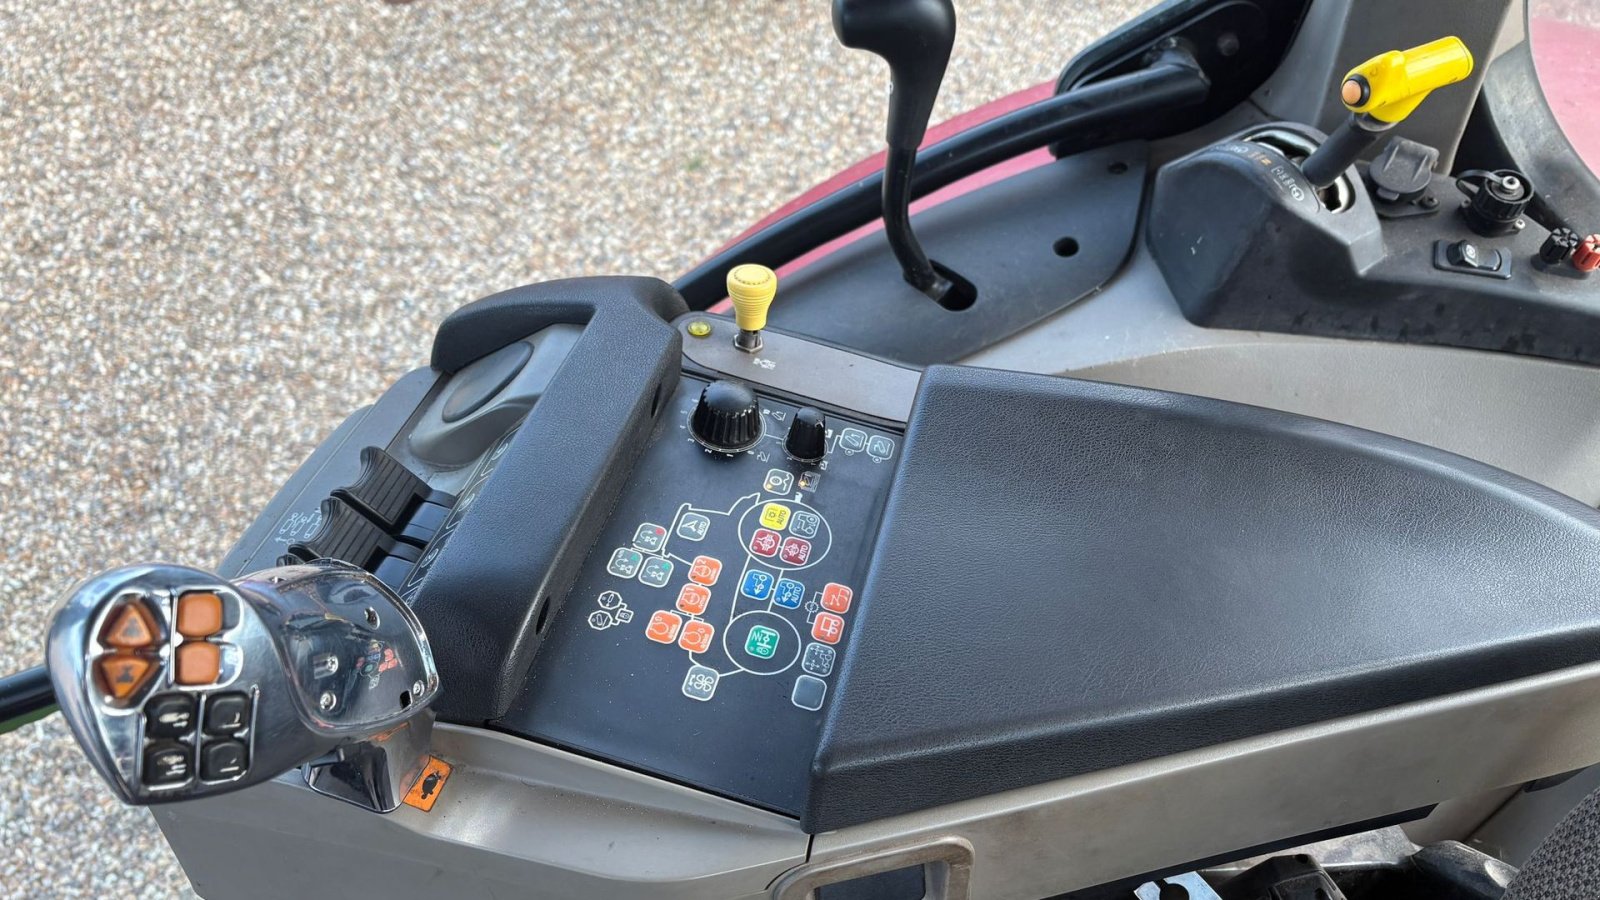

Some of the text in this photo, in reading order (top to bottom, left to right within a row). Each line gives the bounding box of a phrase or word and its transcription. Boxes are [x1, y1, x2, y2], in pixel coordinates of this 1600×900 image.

[776, 510, 786, 525] AUTO
[697, 521, 707, 536] AUTO
[798, 544, 808, 561] AUTO
[790, 586, 802, 603] AUTO
